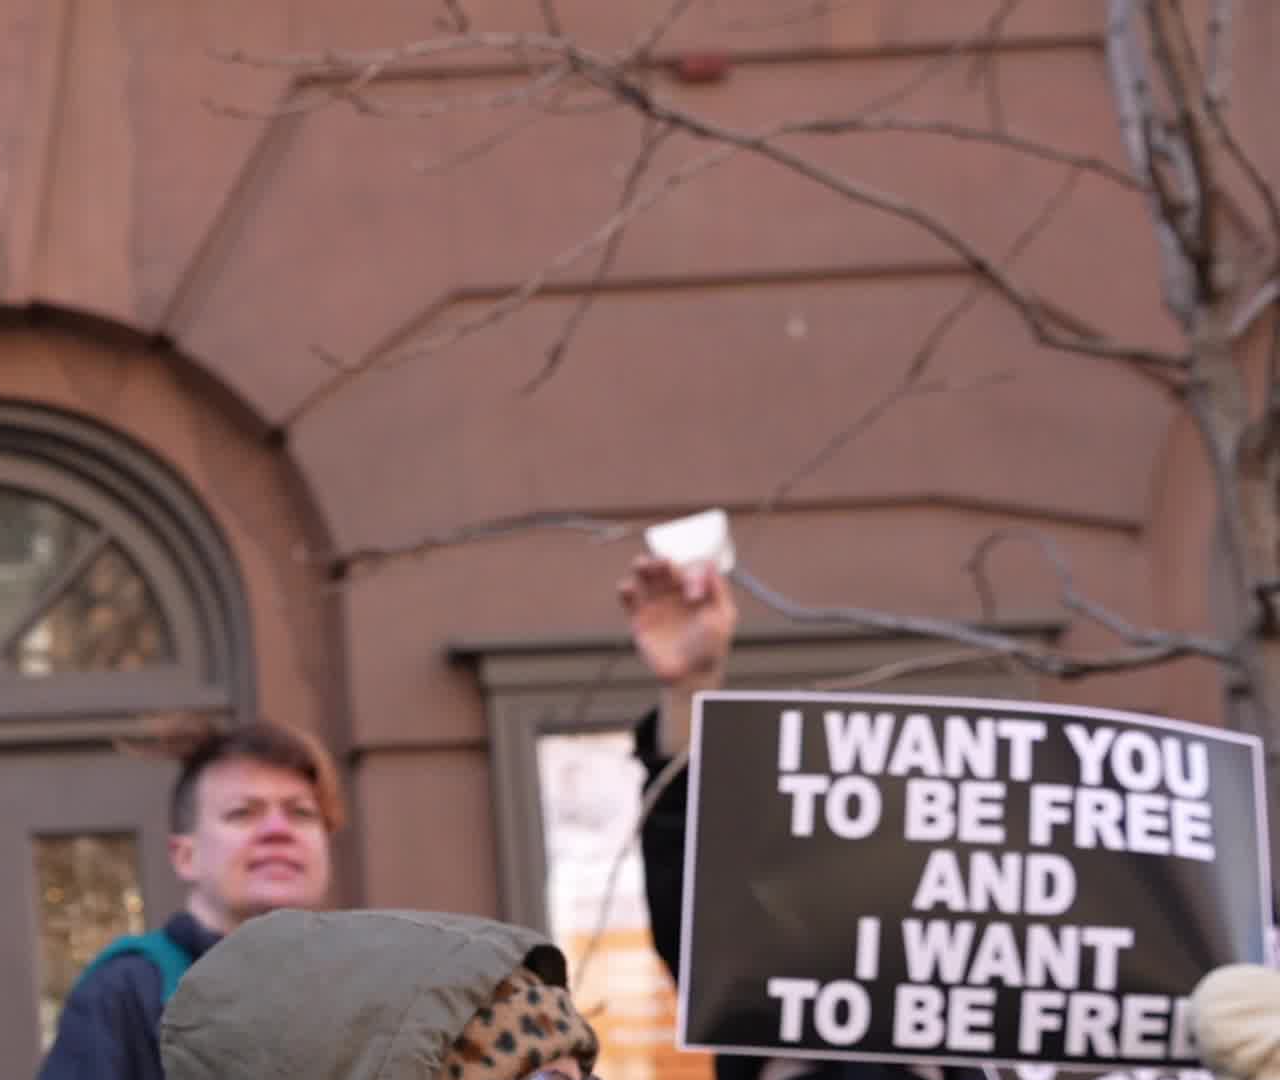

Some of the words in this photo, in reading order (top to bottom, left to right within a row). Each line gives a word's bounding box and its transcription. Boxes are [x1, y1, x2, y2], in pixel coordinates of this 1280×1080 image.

[778, 710, 803, 772] I
[823, 711, 1047, 782] WANT
[1063, 723, 1209, 799] YOU
[777, 774, 882, 840] TO
[903, 778, 1006, 844] BE
[1028, 784, 1216, 862] FREE
[912, 849, 1077, 916] AND
[855, 916, 881, 981] I
[902, 917, 1135, 991] WANT
[767, 977, 872, 1046] TO
[892, 983, 996, 1052] BE
